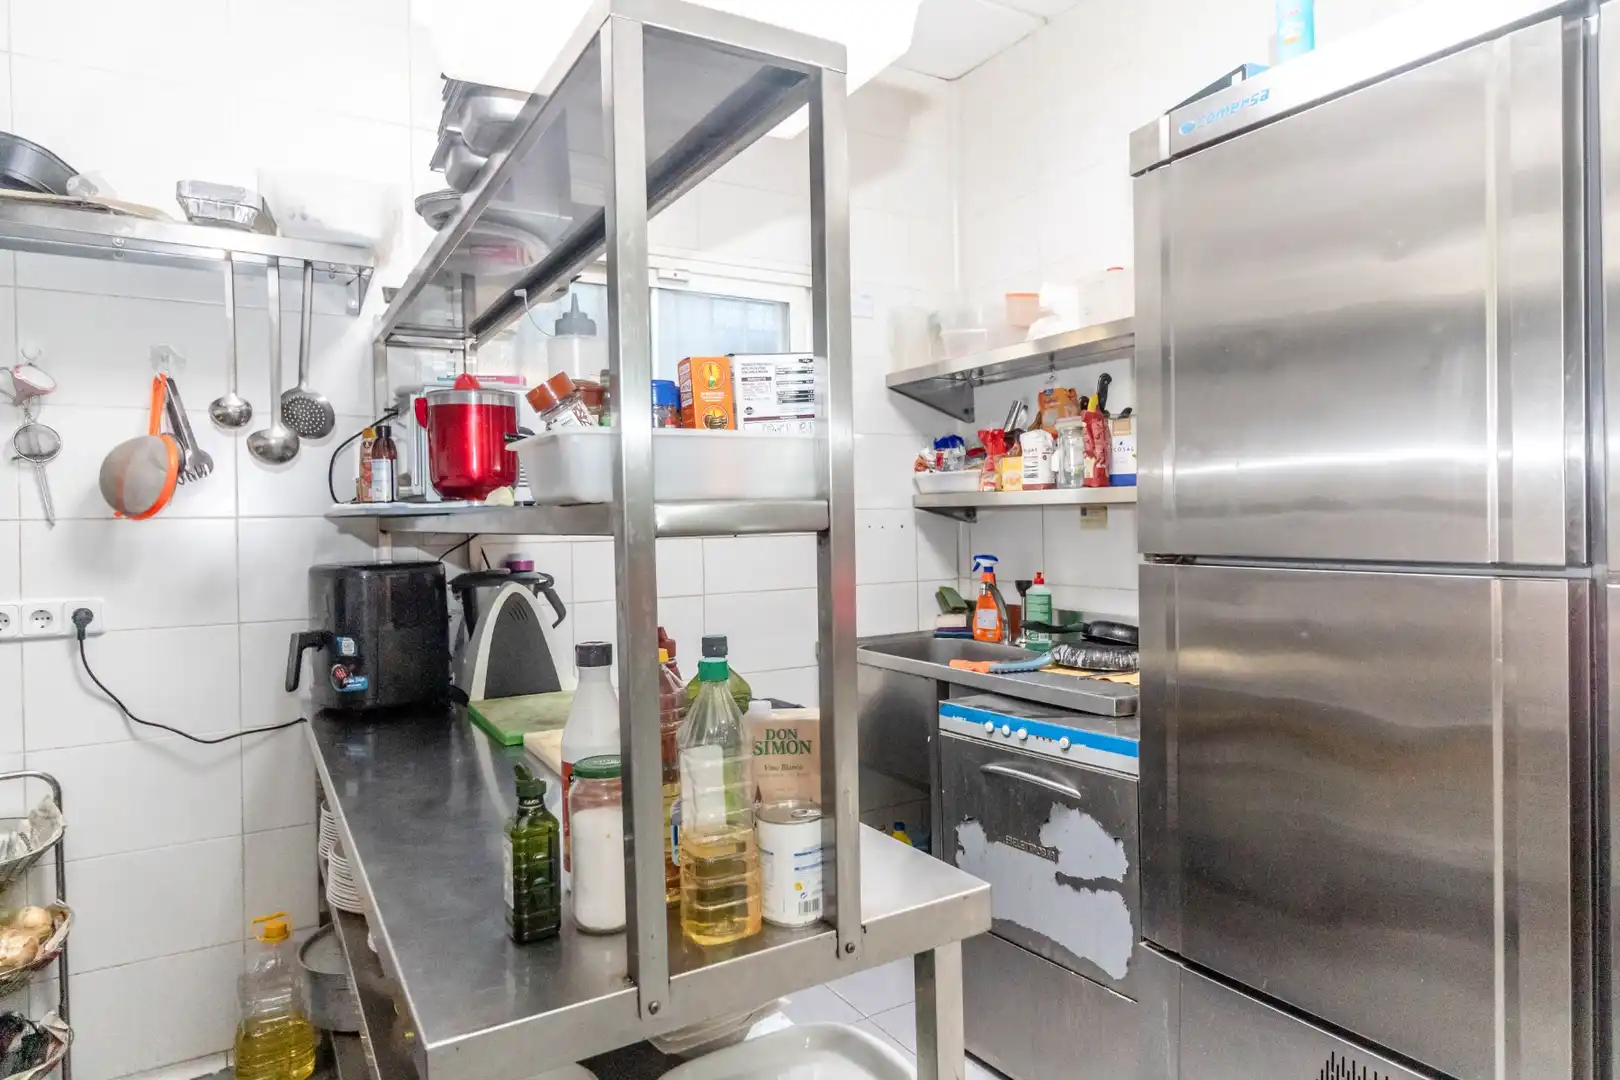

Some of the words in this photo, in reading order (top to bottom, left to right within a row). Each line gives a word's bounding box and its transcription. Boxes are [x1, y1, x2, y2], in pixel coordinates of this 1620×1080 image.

[1198, 88, 1270, 129] comersa
[765, 728, 798, 741] DON
[753, 740, 812, 757] SIMON
[764, 764, 779, 772] Vino
[780, 763, 804, 772] Blanco
